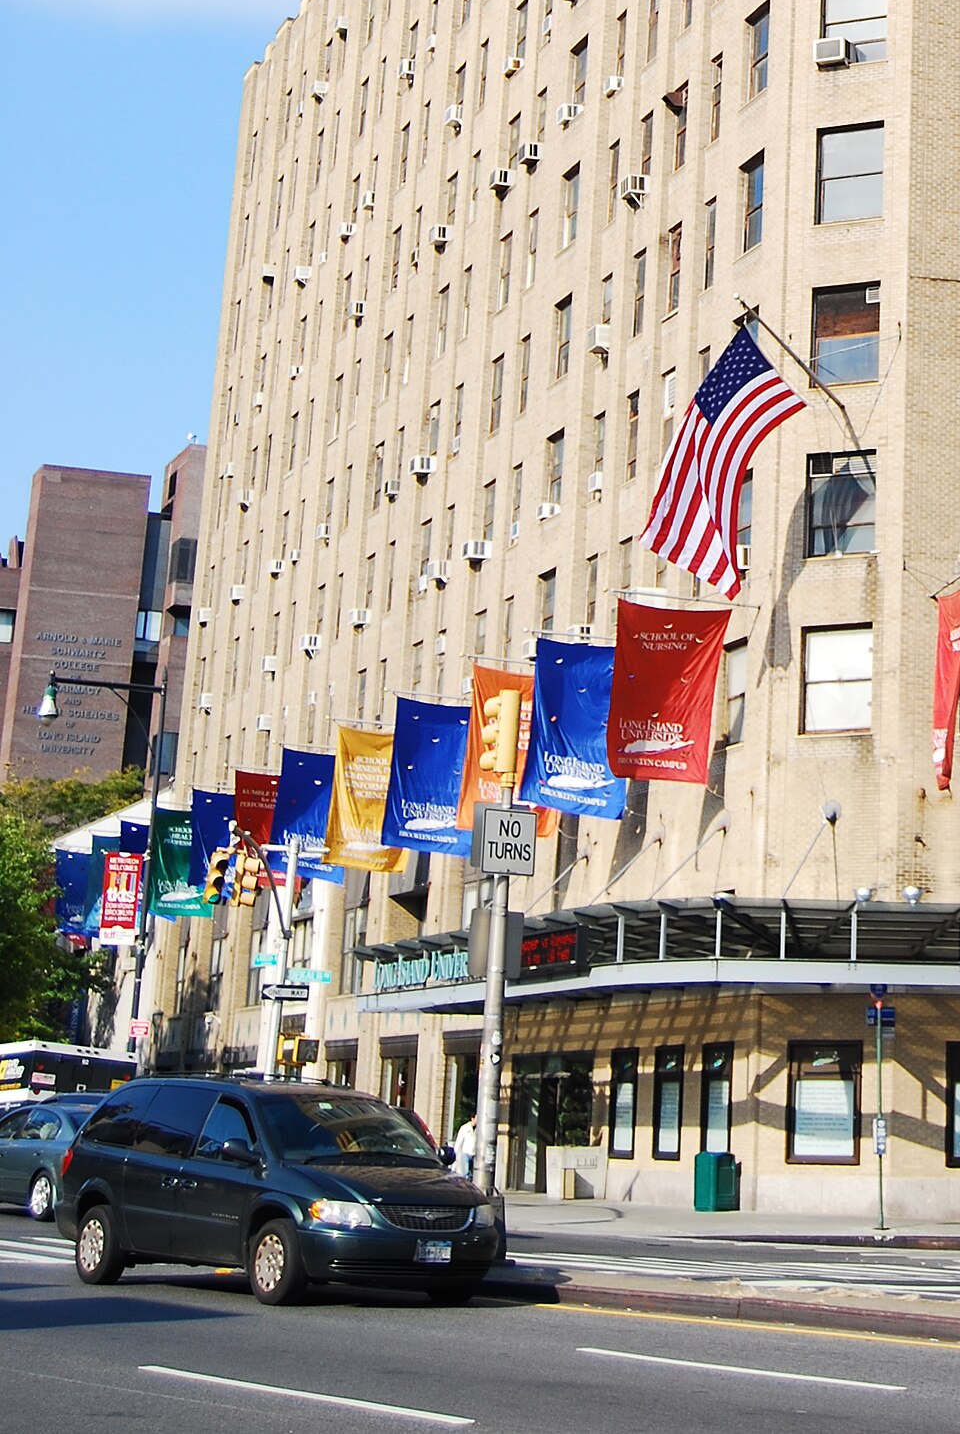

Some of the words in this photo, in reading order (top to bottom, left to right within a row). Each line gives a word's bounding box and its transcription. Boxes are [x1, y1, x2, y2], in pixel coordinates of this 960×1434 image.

[37, 632, 78, 643] ARNOLD
[91, 637, 122, 647] MARIE
[639, 632, 678, 641] SCHOOL
[681, 633, 696, 641] OF
[641, 641, 688, 651] NURSING
[51, 647, 106, 659] SCHWARTZ
[53, 660, 100, 672] COLLEGE
[58, 685, 101, 695] ARMACY
[64, 697, 81, 705] AND
[68, 709, 119, 721] SCIENCES
[619, 718, 646, 730] LONG
[647, 719, 683, 733] ISLAND
[38, 731, 64, 741] LONG
[67, 733, 101, 744] ISLAND
[41, 744, 95, 756] UNIVERSITY
[543, 751, 573, 767] LONG
[573, 756, 606, 774] ISLAND
[618, 757, 654, 767] BROOKLYN
[654, 759, 687, 770] CAMPUS
[240, 801, 276, 809] PERFORMIN
[401, 798, 425, 811] LONG
[426, 801, 456, 815] ISLAND
[577, 794, 608, 807] CAMPUS
[499, 819, 521, 839] NO
[488, 840, 532, 862] TURNS
[374, 956, 398, 990] LONG
[398, 954, 430, 986] ISLAND
[430, 950, 469, 982] UNIVER
